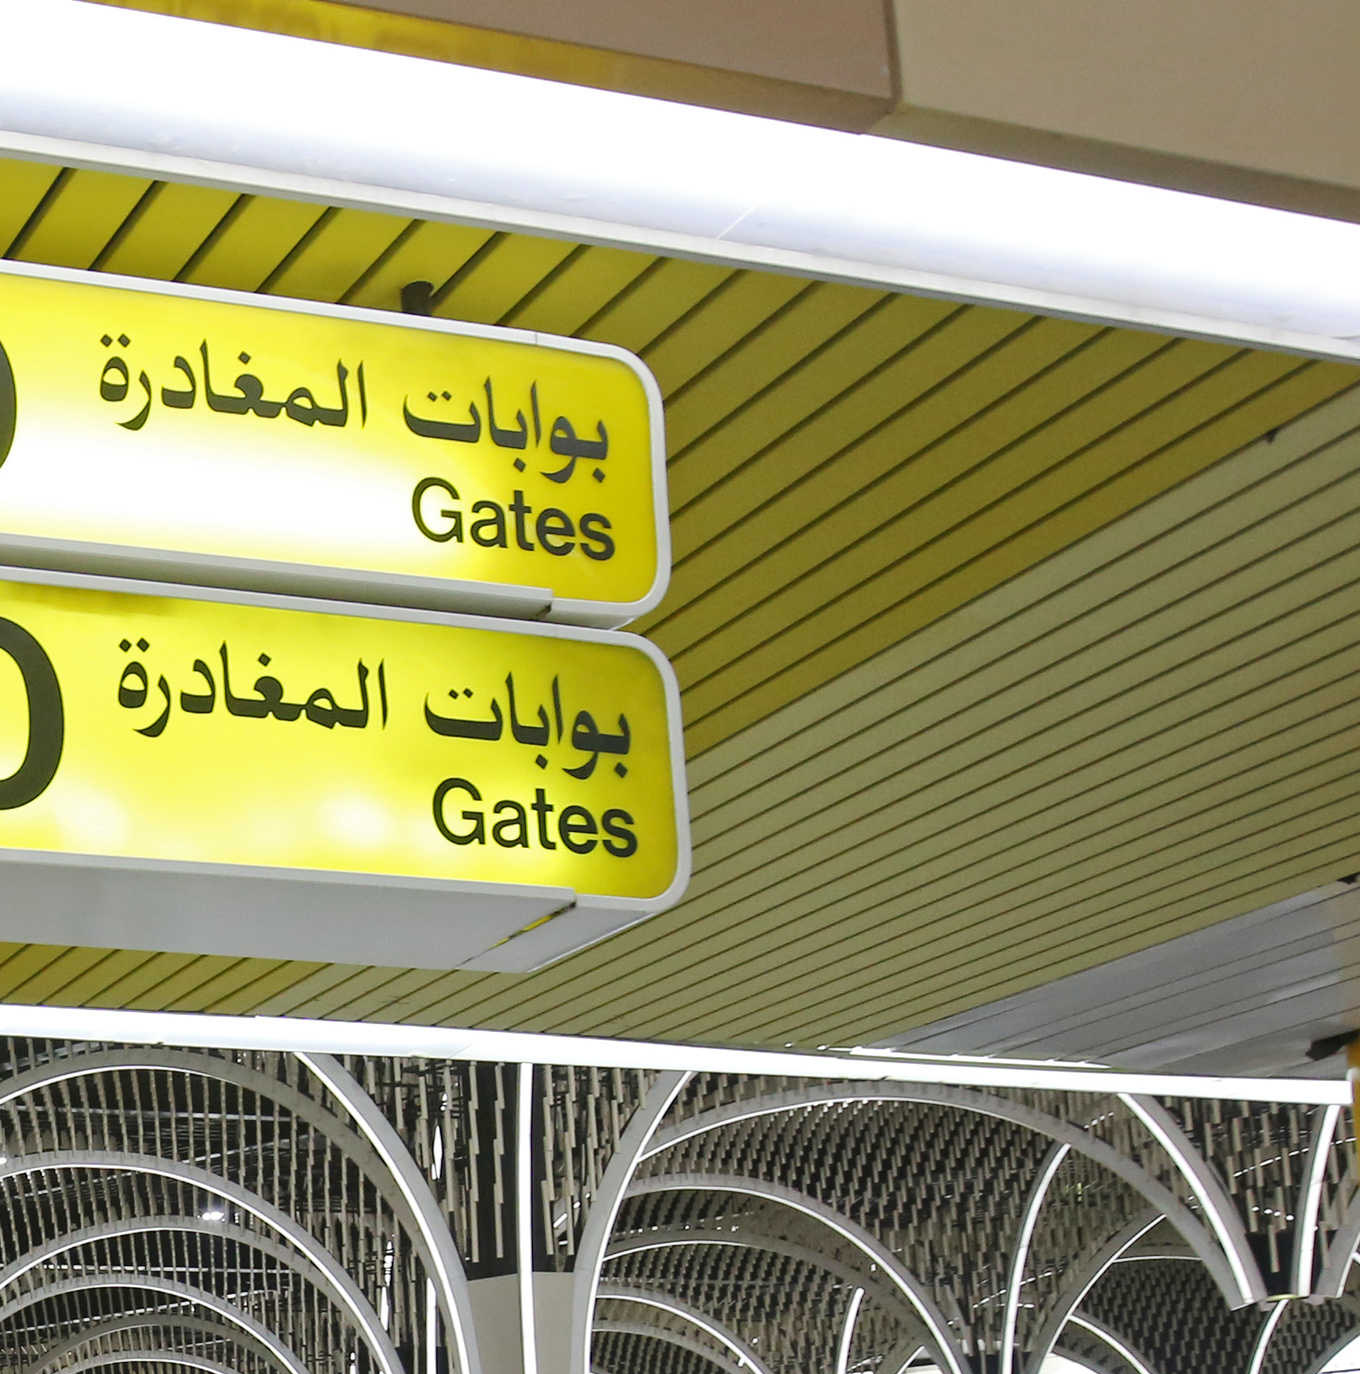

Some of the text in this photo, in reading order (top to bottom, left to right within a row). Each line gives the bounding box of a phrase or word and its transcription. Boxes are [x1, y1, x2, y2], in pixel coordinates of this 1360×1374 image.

[100, 334, 608, 487] بوابات المغادرة
[412, 477, 616, 561] Gates
[118, 638, 631, 780] بوابات المغادرة
[433, 778, 638, 858] Gates
